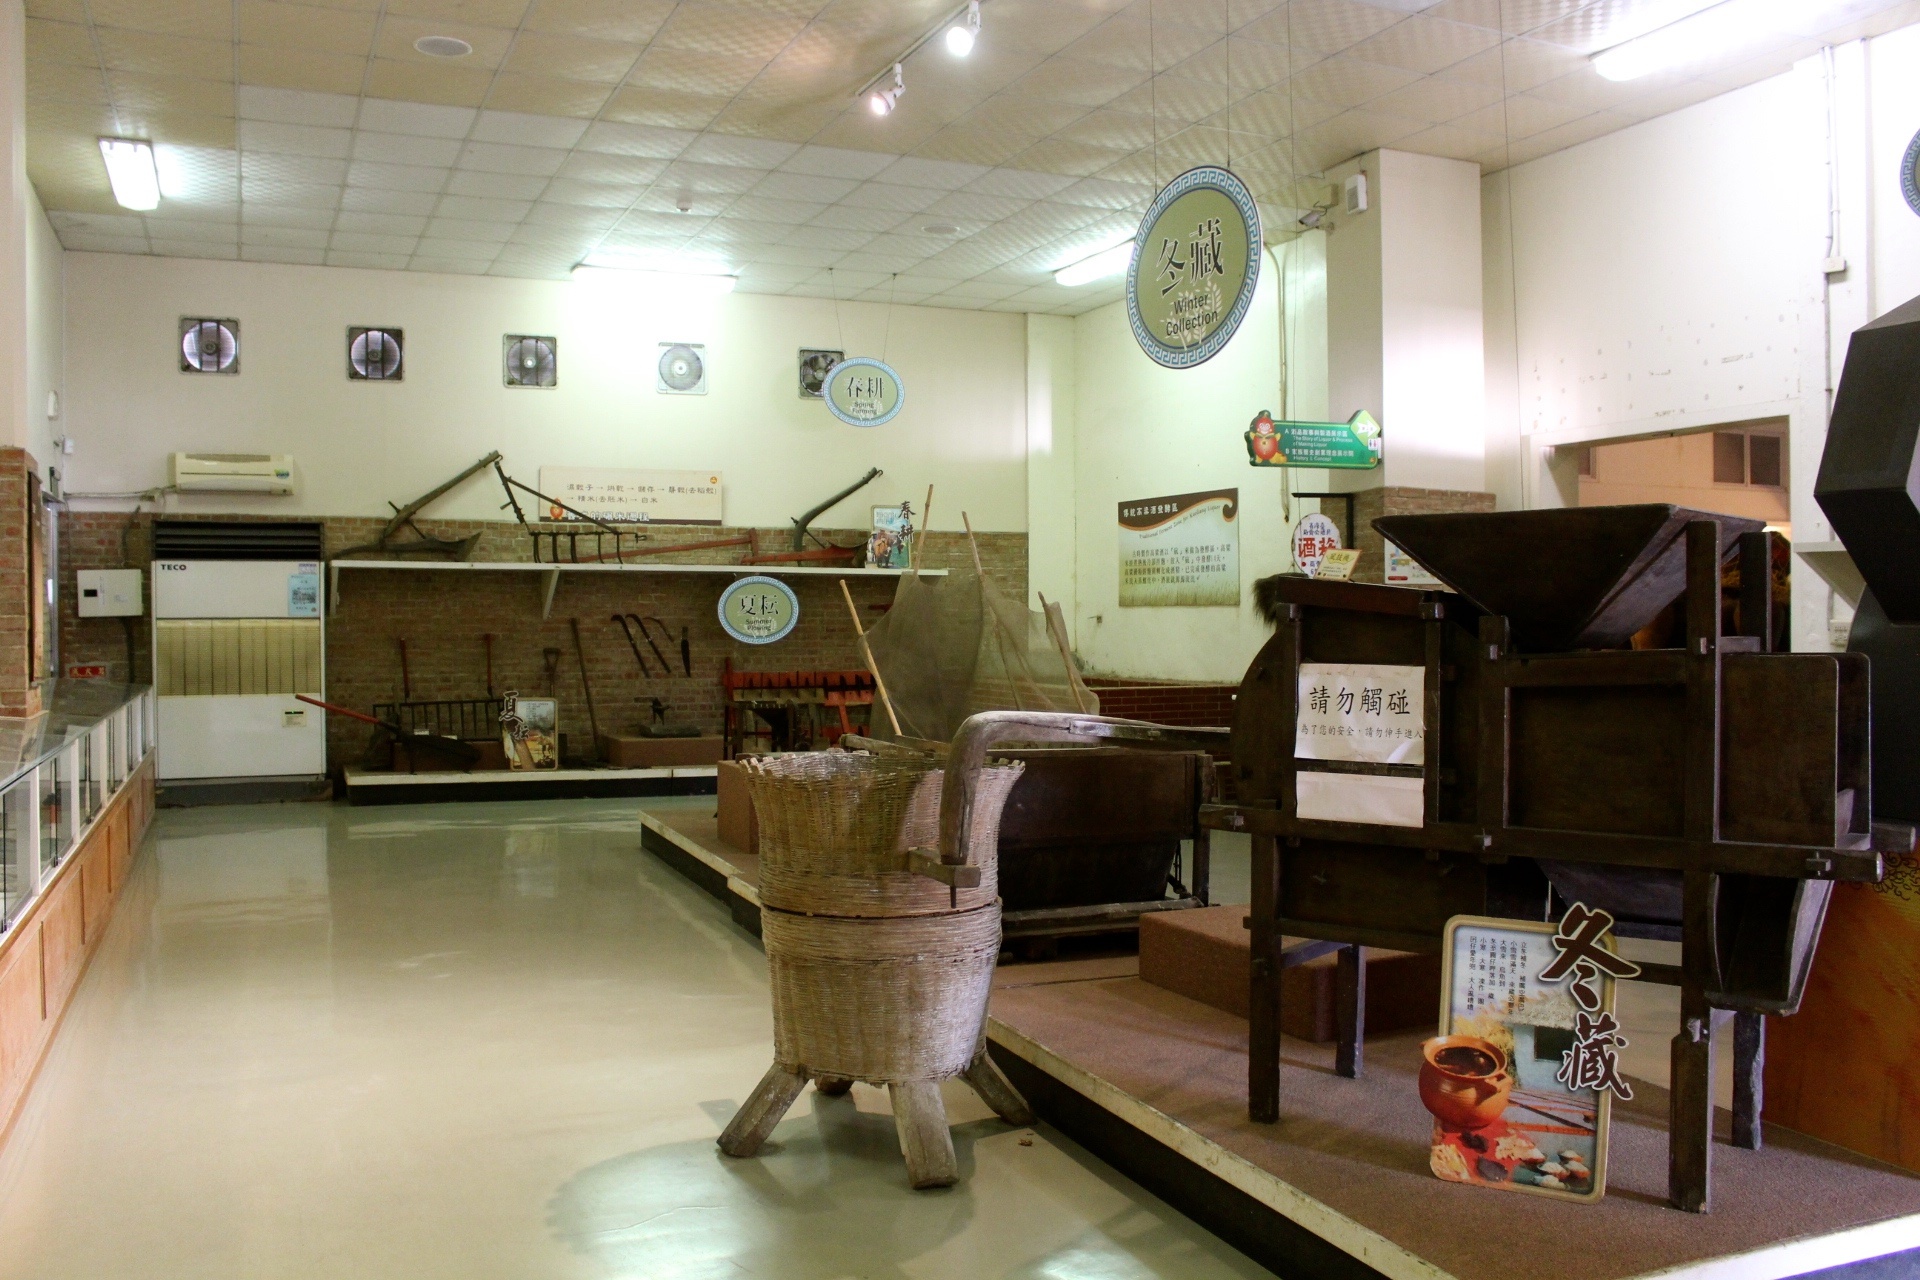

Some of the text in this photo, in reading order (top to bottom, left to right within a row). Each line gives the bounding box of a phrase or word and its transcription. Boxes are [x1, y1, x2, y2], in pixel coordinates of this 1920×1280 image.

[1156, 218, 1224, 298] 冬藏
[1173, 294, 1209, 315] Winter
[1166, 310, 1218, 336] Collection
[845, 376, 885, 399] 春耕
[1309, 685, 1411, 716] 請勿觸碰
[1538, 901, 1642, 1100] 冬藏
